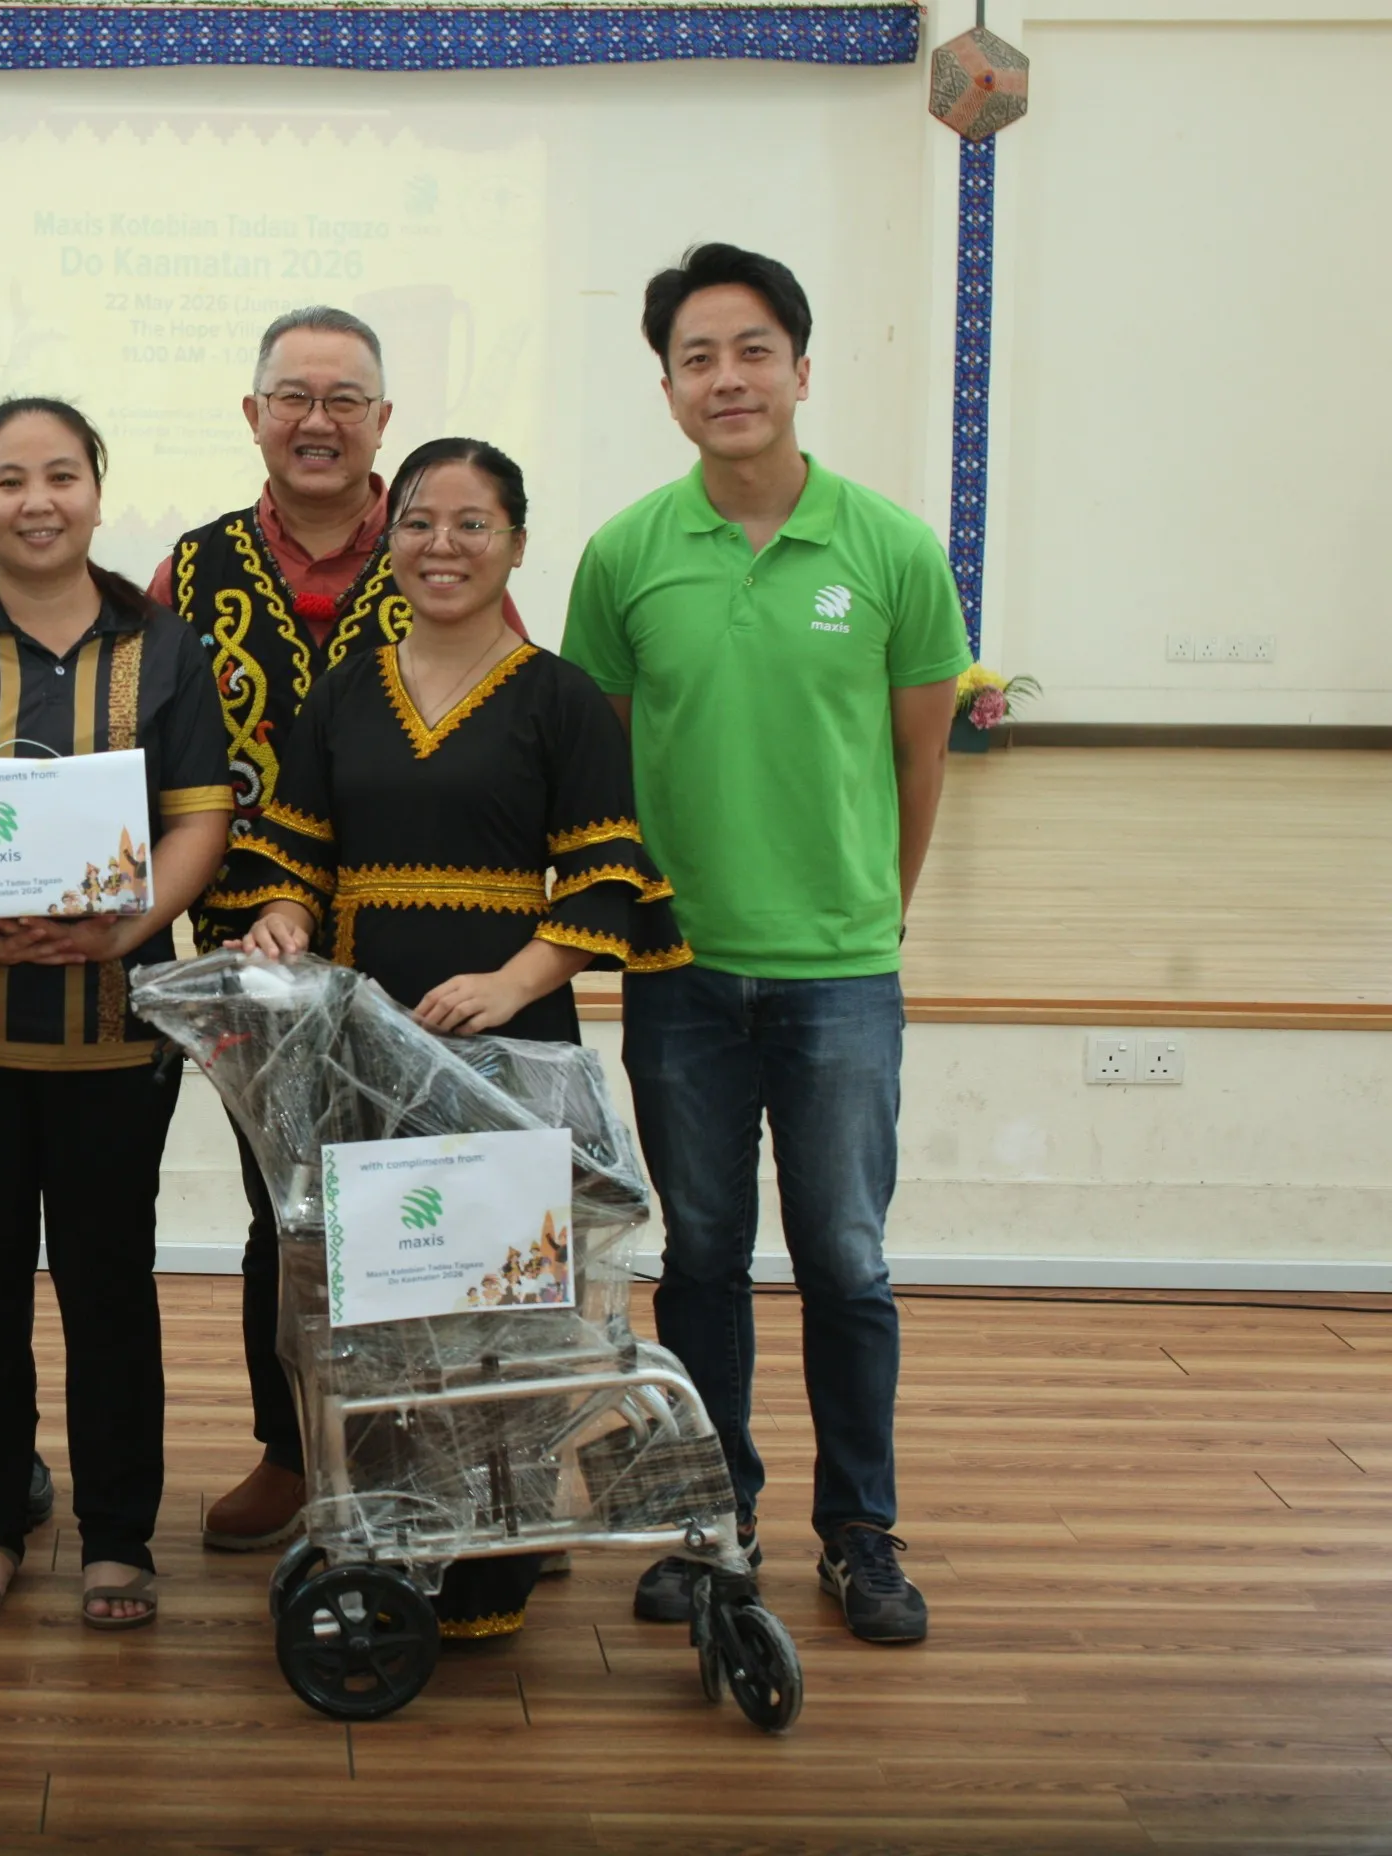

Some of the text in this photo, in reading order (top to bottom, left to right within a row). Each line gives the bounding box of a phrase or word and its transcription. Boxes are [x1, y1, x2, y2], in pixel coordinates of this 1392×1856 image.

[33, 211, 103, 237] Maxis
[59, 246, 364, 280] Do Kaamatan 2026
[104, 293, 128, 311] 22
[134, 293, 175, 313] May
[179, 294, 228, 312] 2026
[129, 319, 165, 337] The
[170, 320, 220, 340] Hope
[174, 345, 206, 363] AM
[811, 621, 851, 633] maxis
[30, 770, 60, 780] from:
[21, 887, 43, 895] 2026
[359, 1154, 485, 1171] with compliments from:
[398, 1234, 445, 1250] maxis
